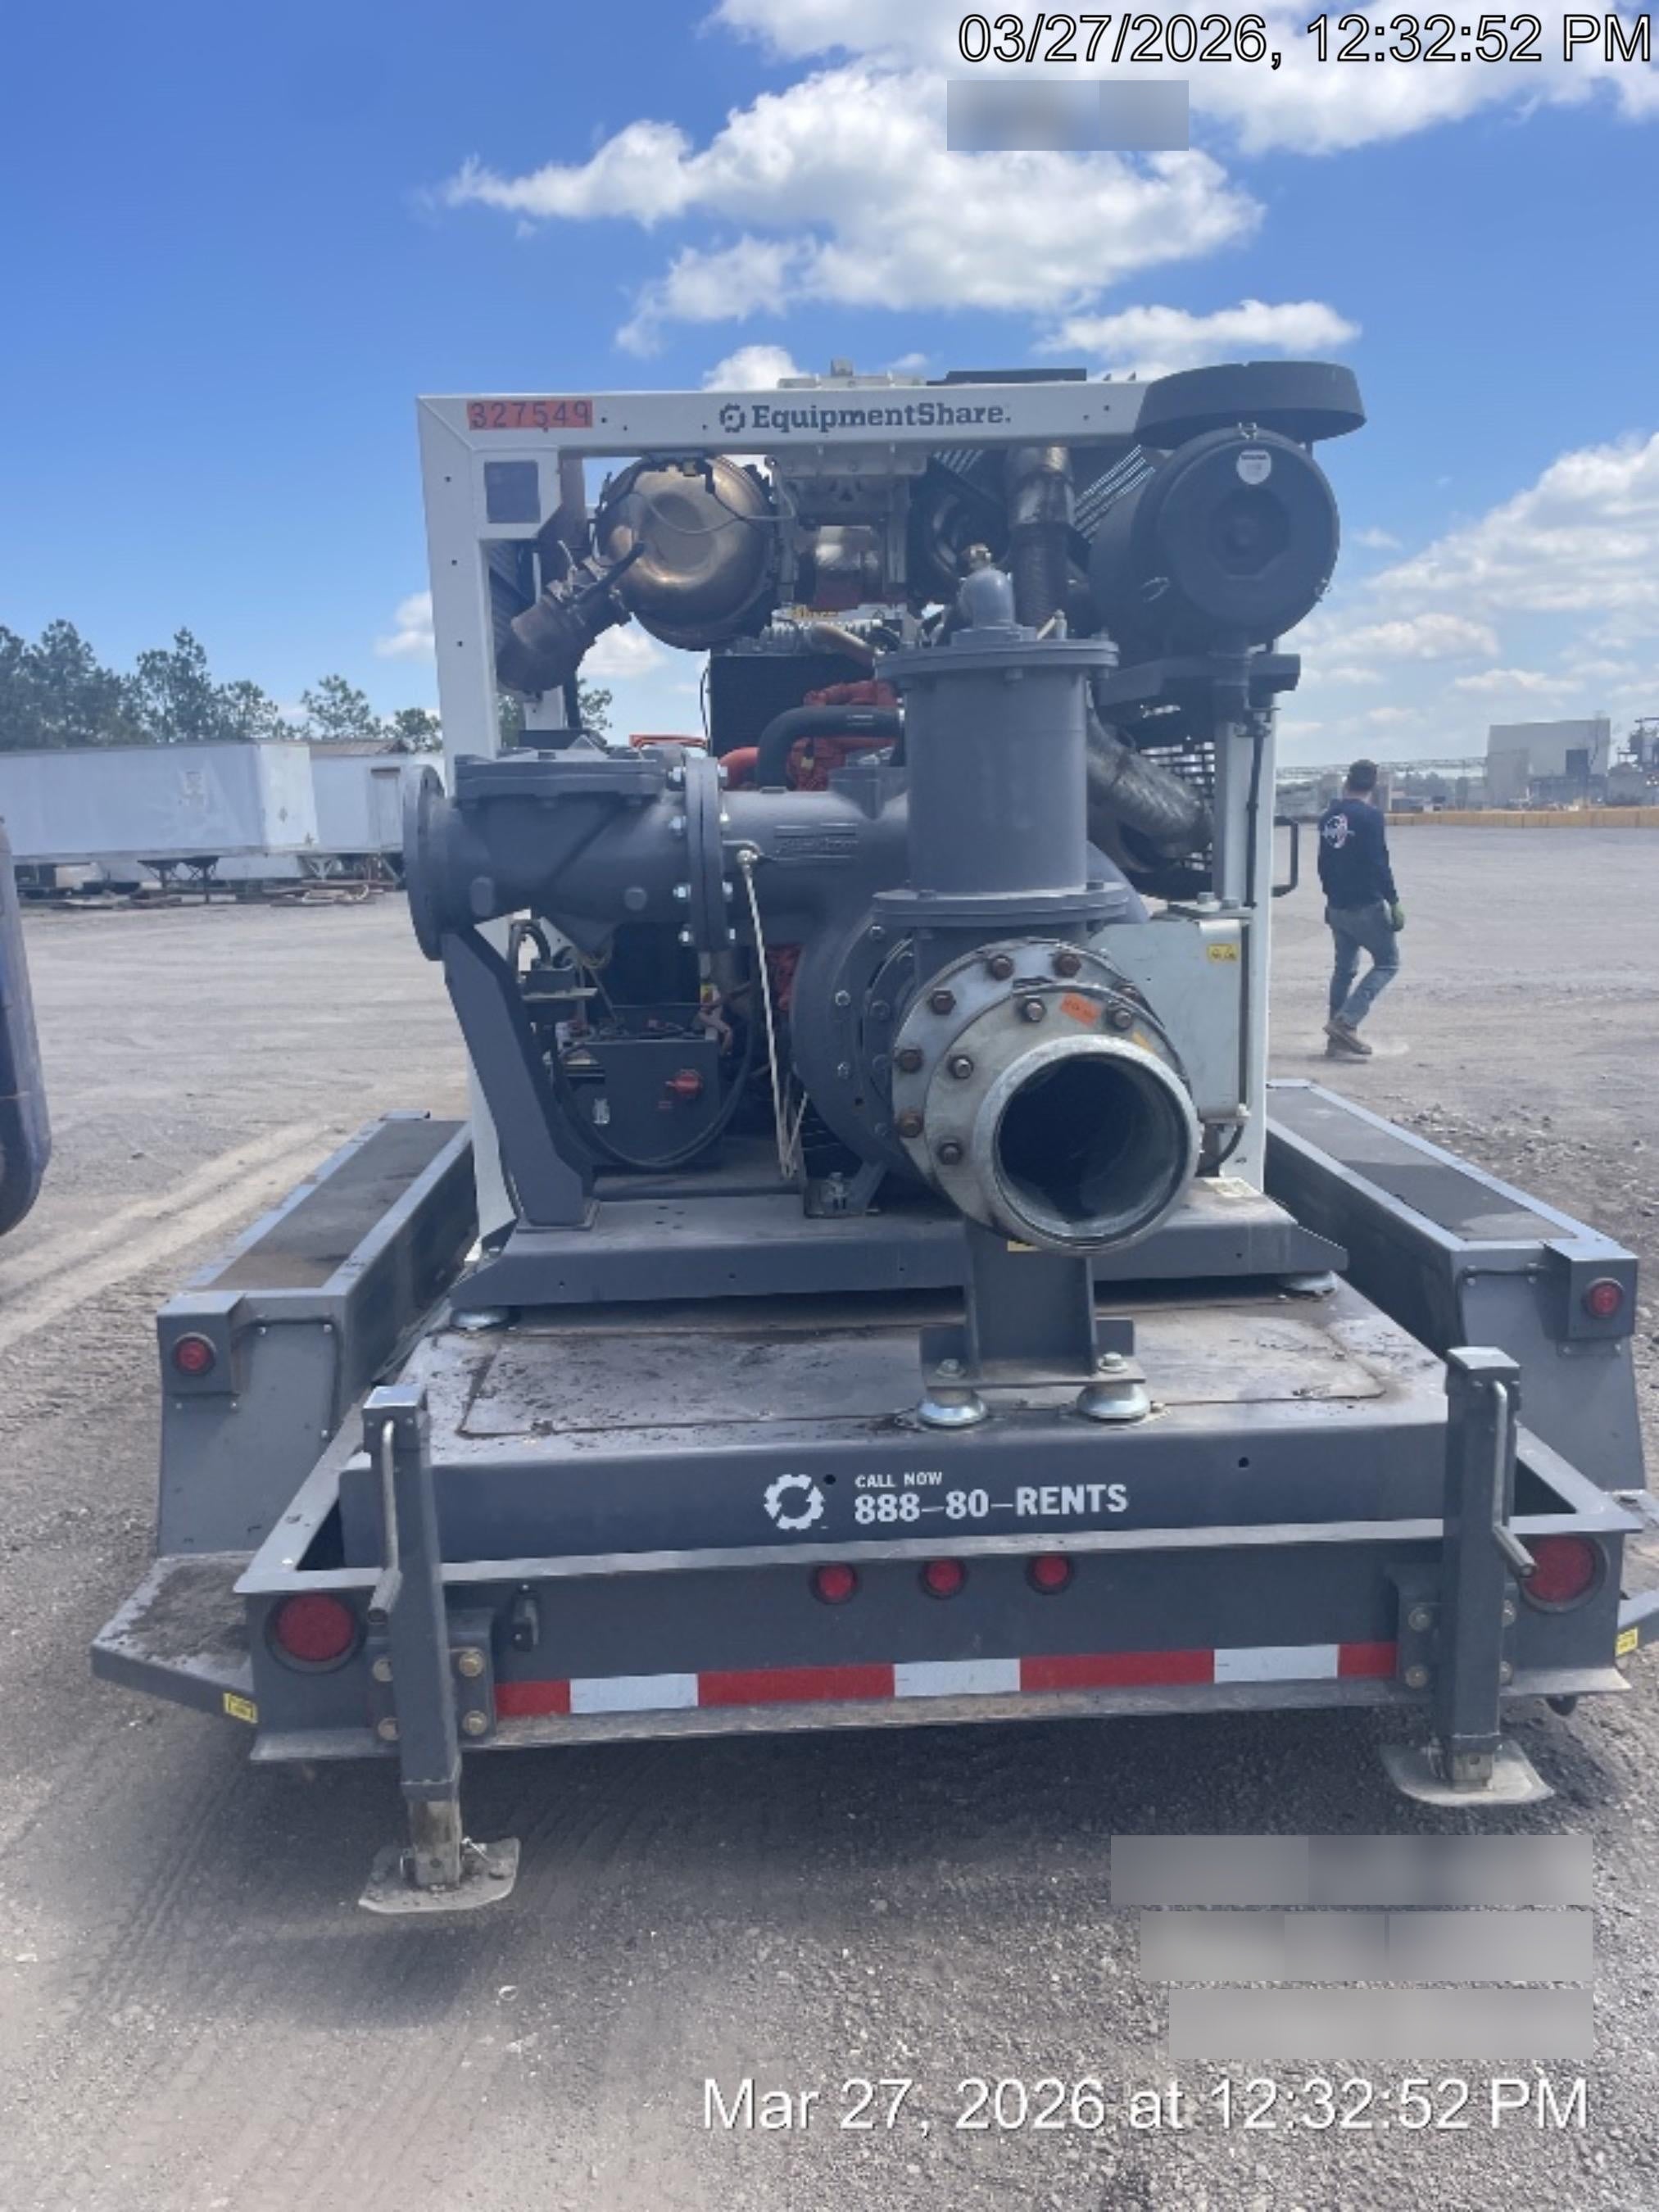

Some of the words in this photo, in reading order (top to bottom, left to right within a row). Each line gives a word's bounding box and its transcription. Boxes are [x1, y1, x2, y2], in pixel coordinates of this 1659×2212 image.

[470, 401, 591, 428] 327549
[854, 1474, 896, 1489] CALL
[904, 1471, 943, 1486] NOW
[854, 1483, 1130, 1525] 888-80-RENTS
